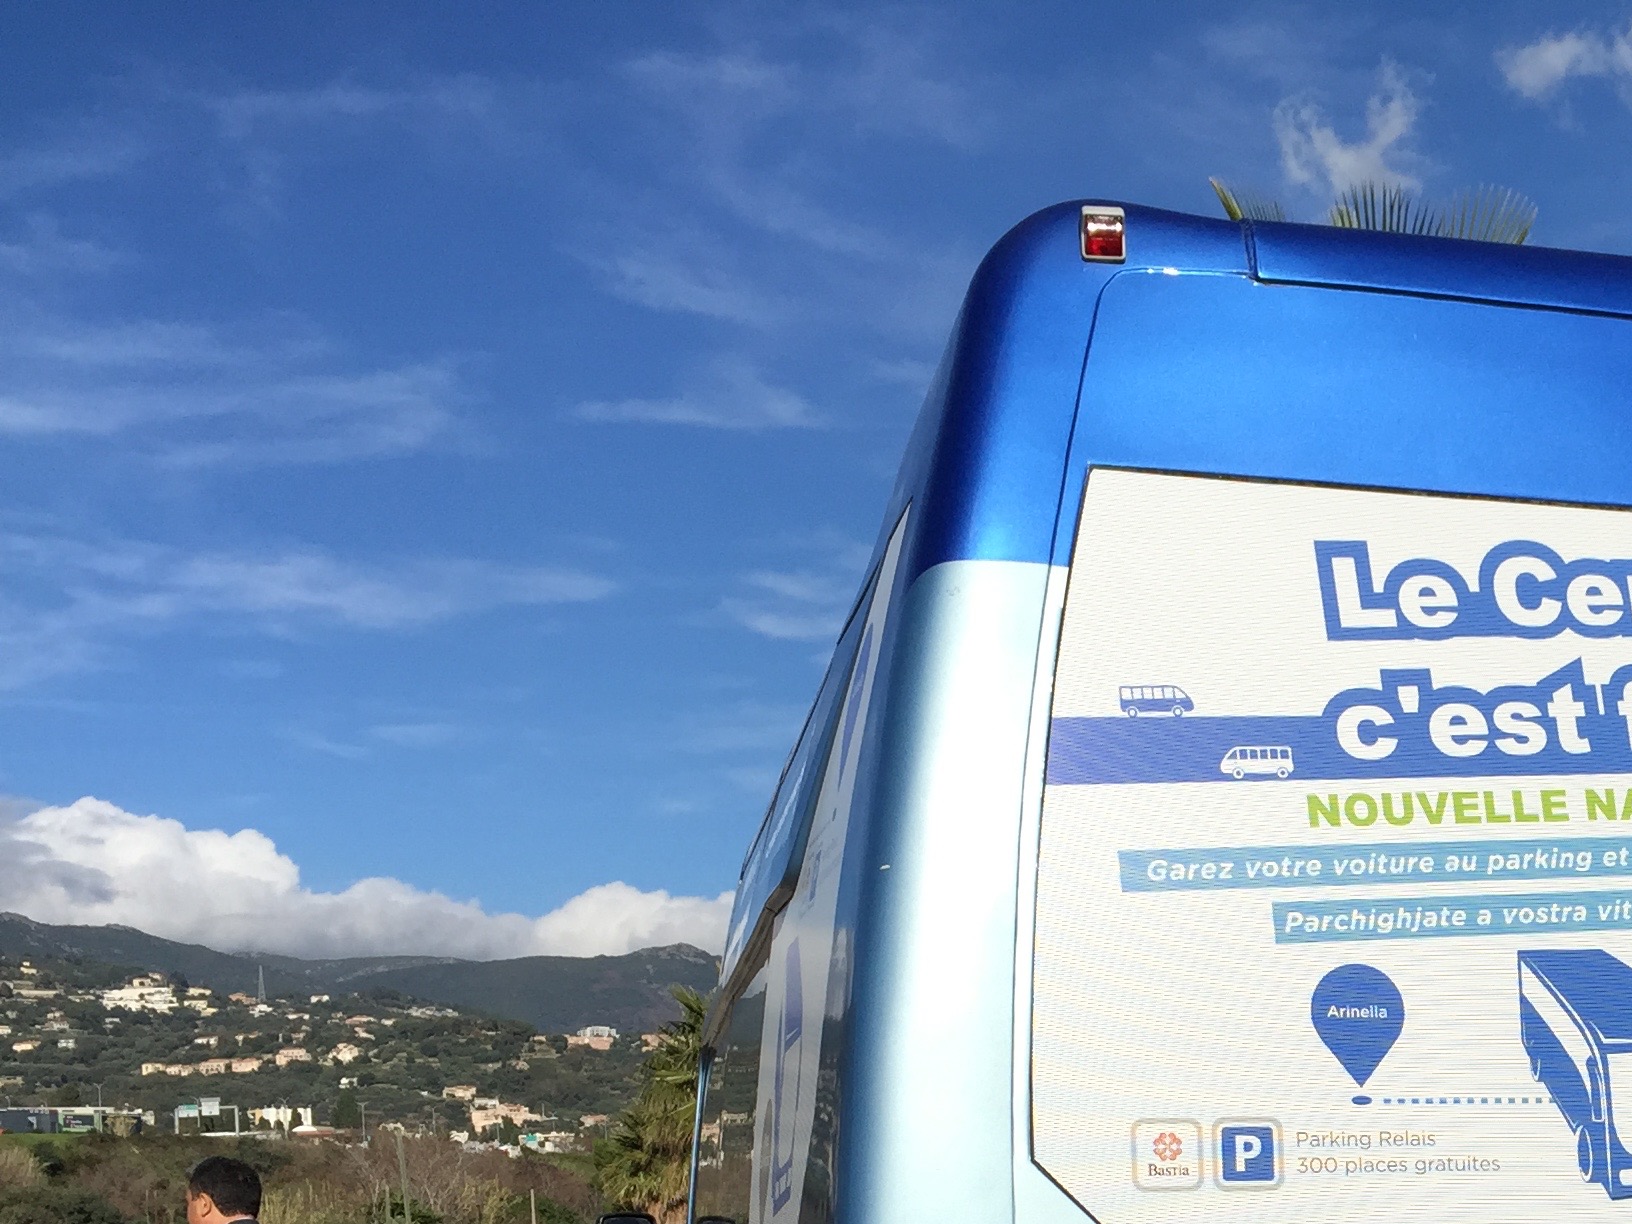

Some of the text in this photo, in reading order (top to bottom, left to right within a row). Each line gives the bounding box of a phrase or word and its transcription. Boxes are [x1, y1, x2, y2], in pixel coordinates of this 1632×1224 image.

[1331, 556, 1459, 629] Le
[1336, 683, 1592, 761] c'est
[1306, 789, 1570, 828] NOUVELLE
[1147, 858, 1234, 881] Garez
[1246, 855, 1322, 878] votre
[1334, 851, 1434, 876] voiture
[1444, 853, 1477, 873] au
[1486, 847, 1592, 875] parking
[1603, 846, 1628, 867] et
[1284, 905, 1466, 934] Parchighjate
[1477, 909, 1491, 925] a
[1502, 903, 1587, 925] vostra
[1327, 1005, 1388, 1019] Arinella
[1233, 1134, 1262, 1172] P
[1297, 1131, 1436, 1149] Parking Relais
[1296, 1155, 1501, 1177] 300 places gratuites
